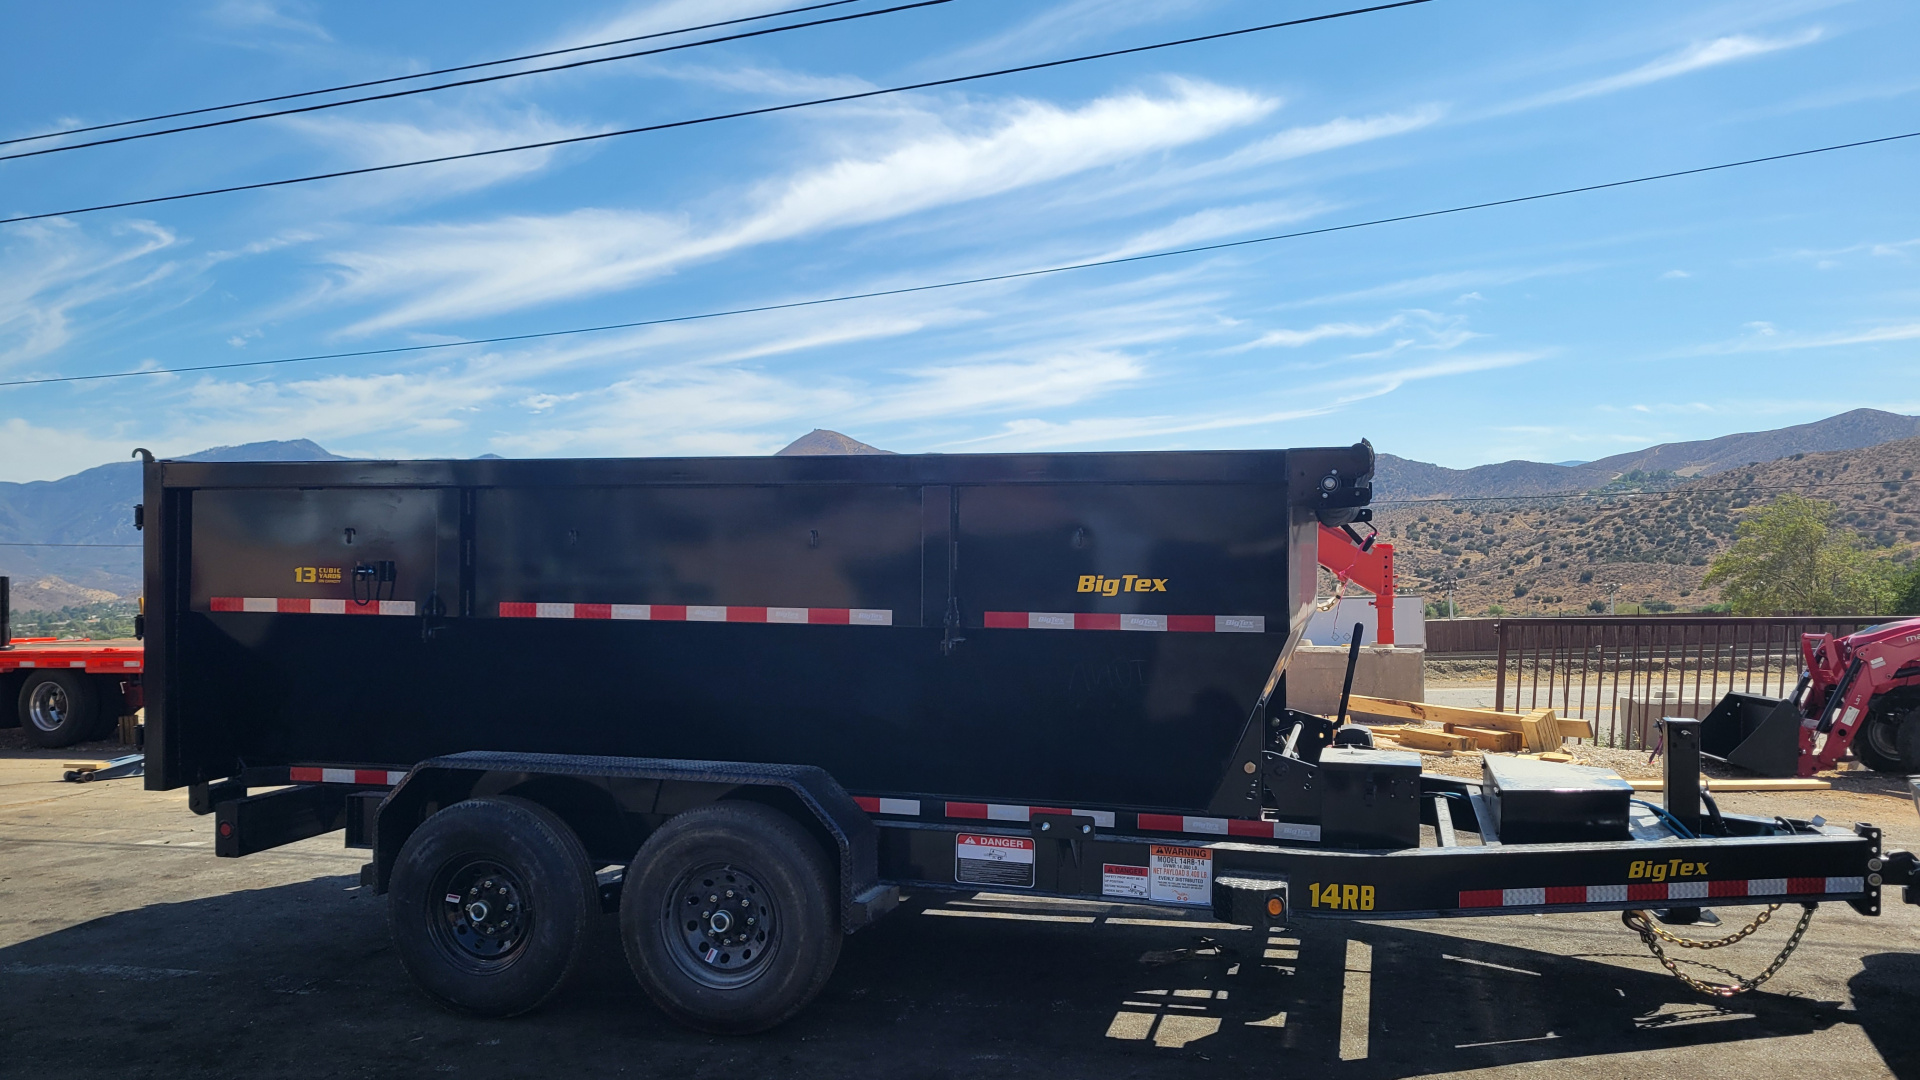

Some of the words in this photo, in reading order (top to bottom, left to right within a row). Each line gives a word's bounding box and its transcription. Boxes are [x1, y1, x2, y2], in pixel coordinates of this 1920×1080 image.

[294, 566, 317, 583] 13
[1077, 574, 1168, 596] BigTex
[980, 837, 1024, 848] DANGER
[1164, 846, 1206, 858] WARNING
[1158, 856, 1178, 864] MODEL
[1164, 868, 1185, 876] PAYLOAD
[1628, 859, 1710, 882] BigTex
[1309, 882, 1375, 910] 14RB
